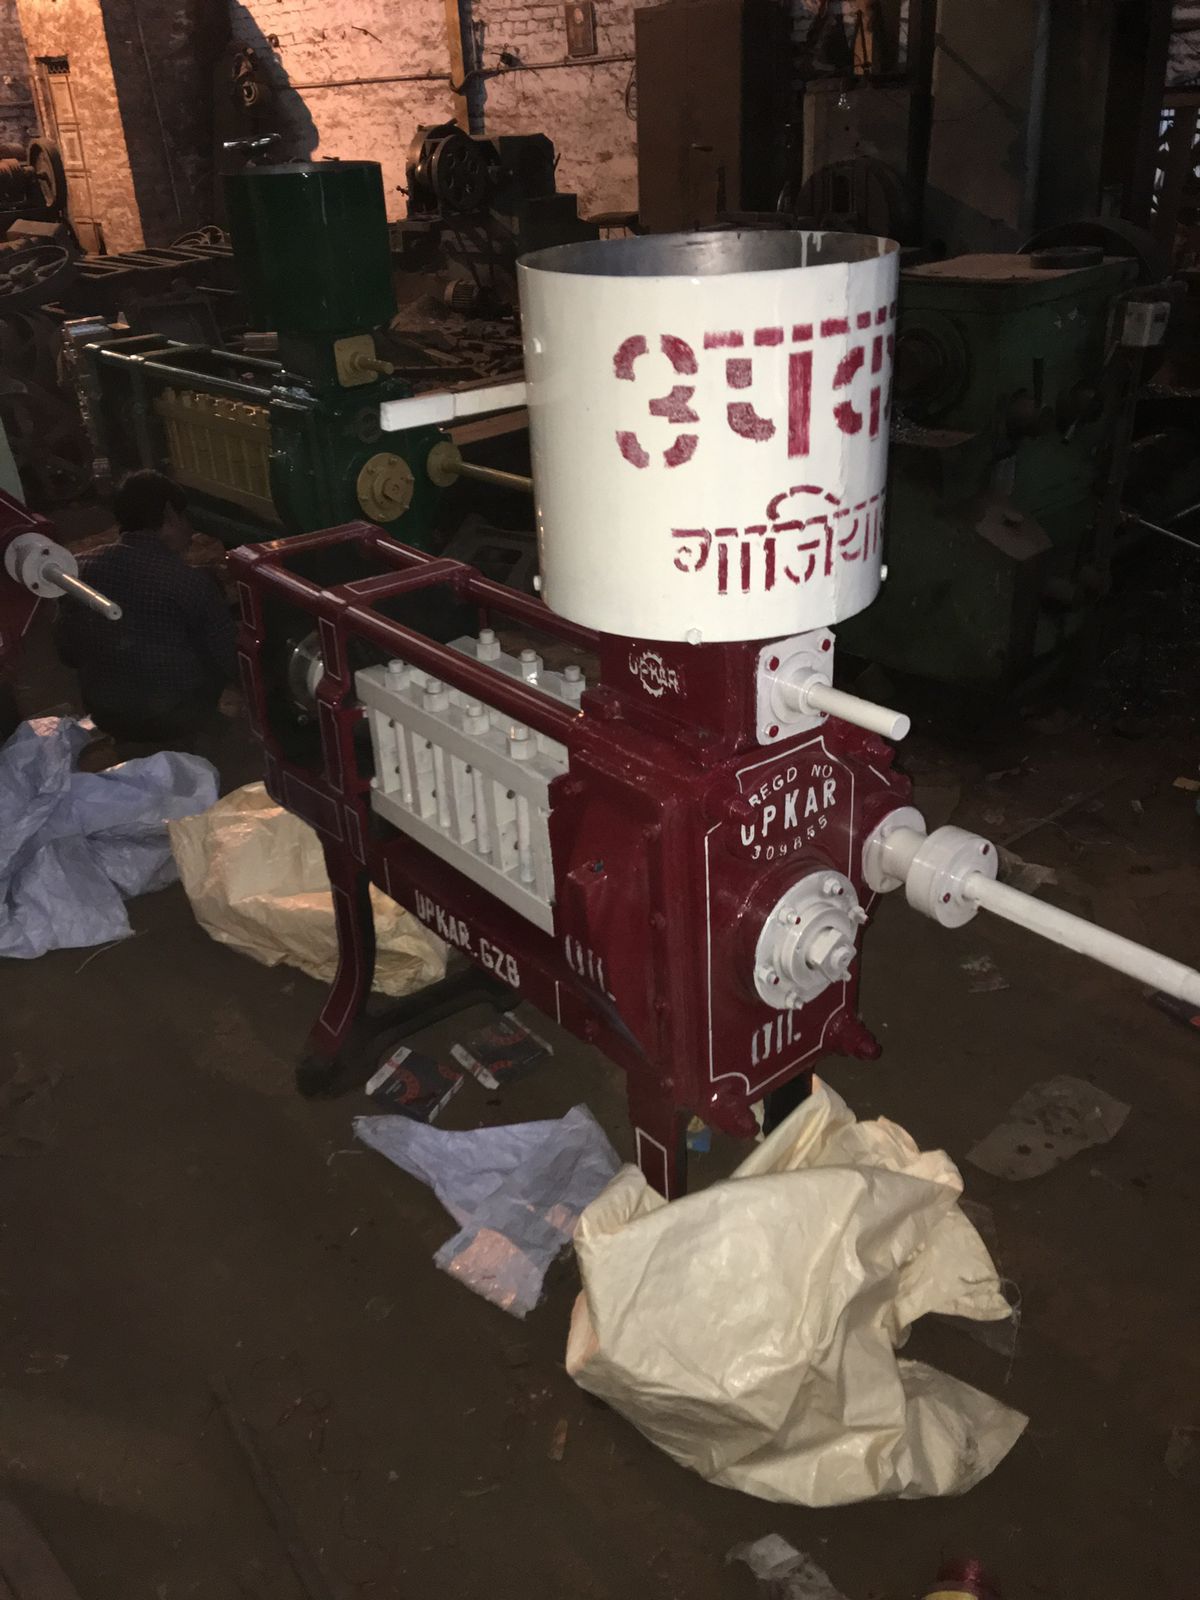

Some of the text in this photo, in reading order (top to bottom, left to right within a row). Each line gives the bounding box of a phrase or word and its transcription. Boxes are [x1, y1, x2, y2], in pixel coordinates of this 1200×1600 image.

[740, 778, 836, 846] UPKAR
[748, 764, 833, 807] REGD NO
